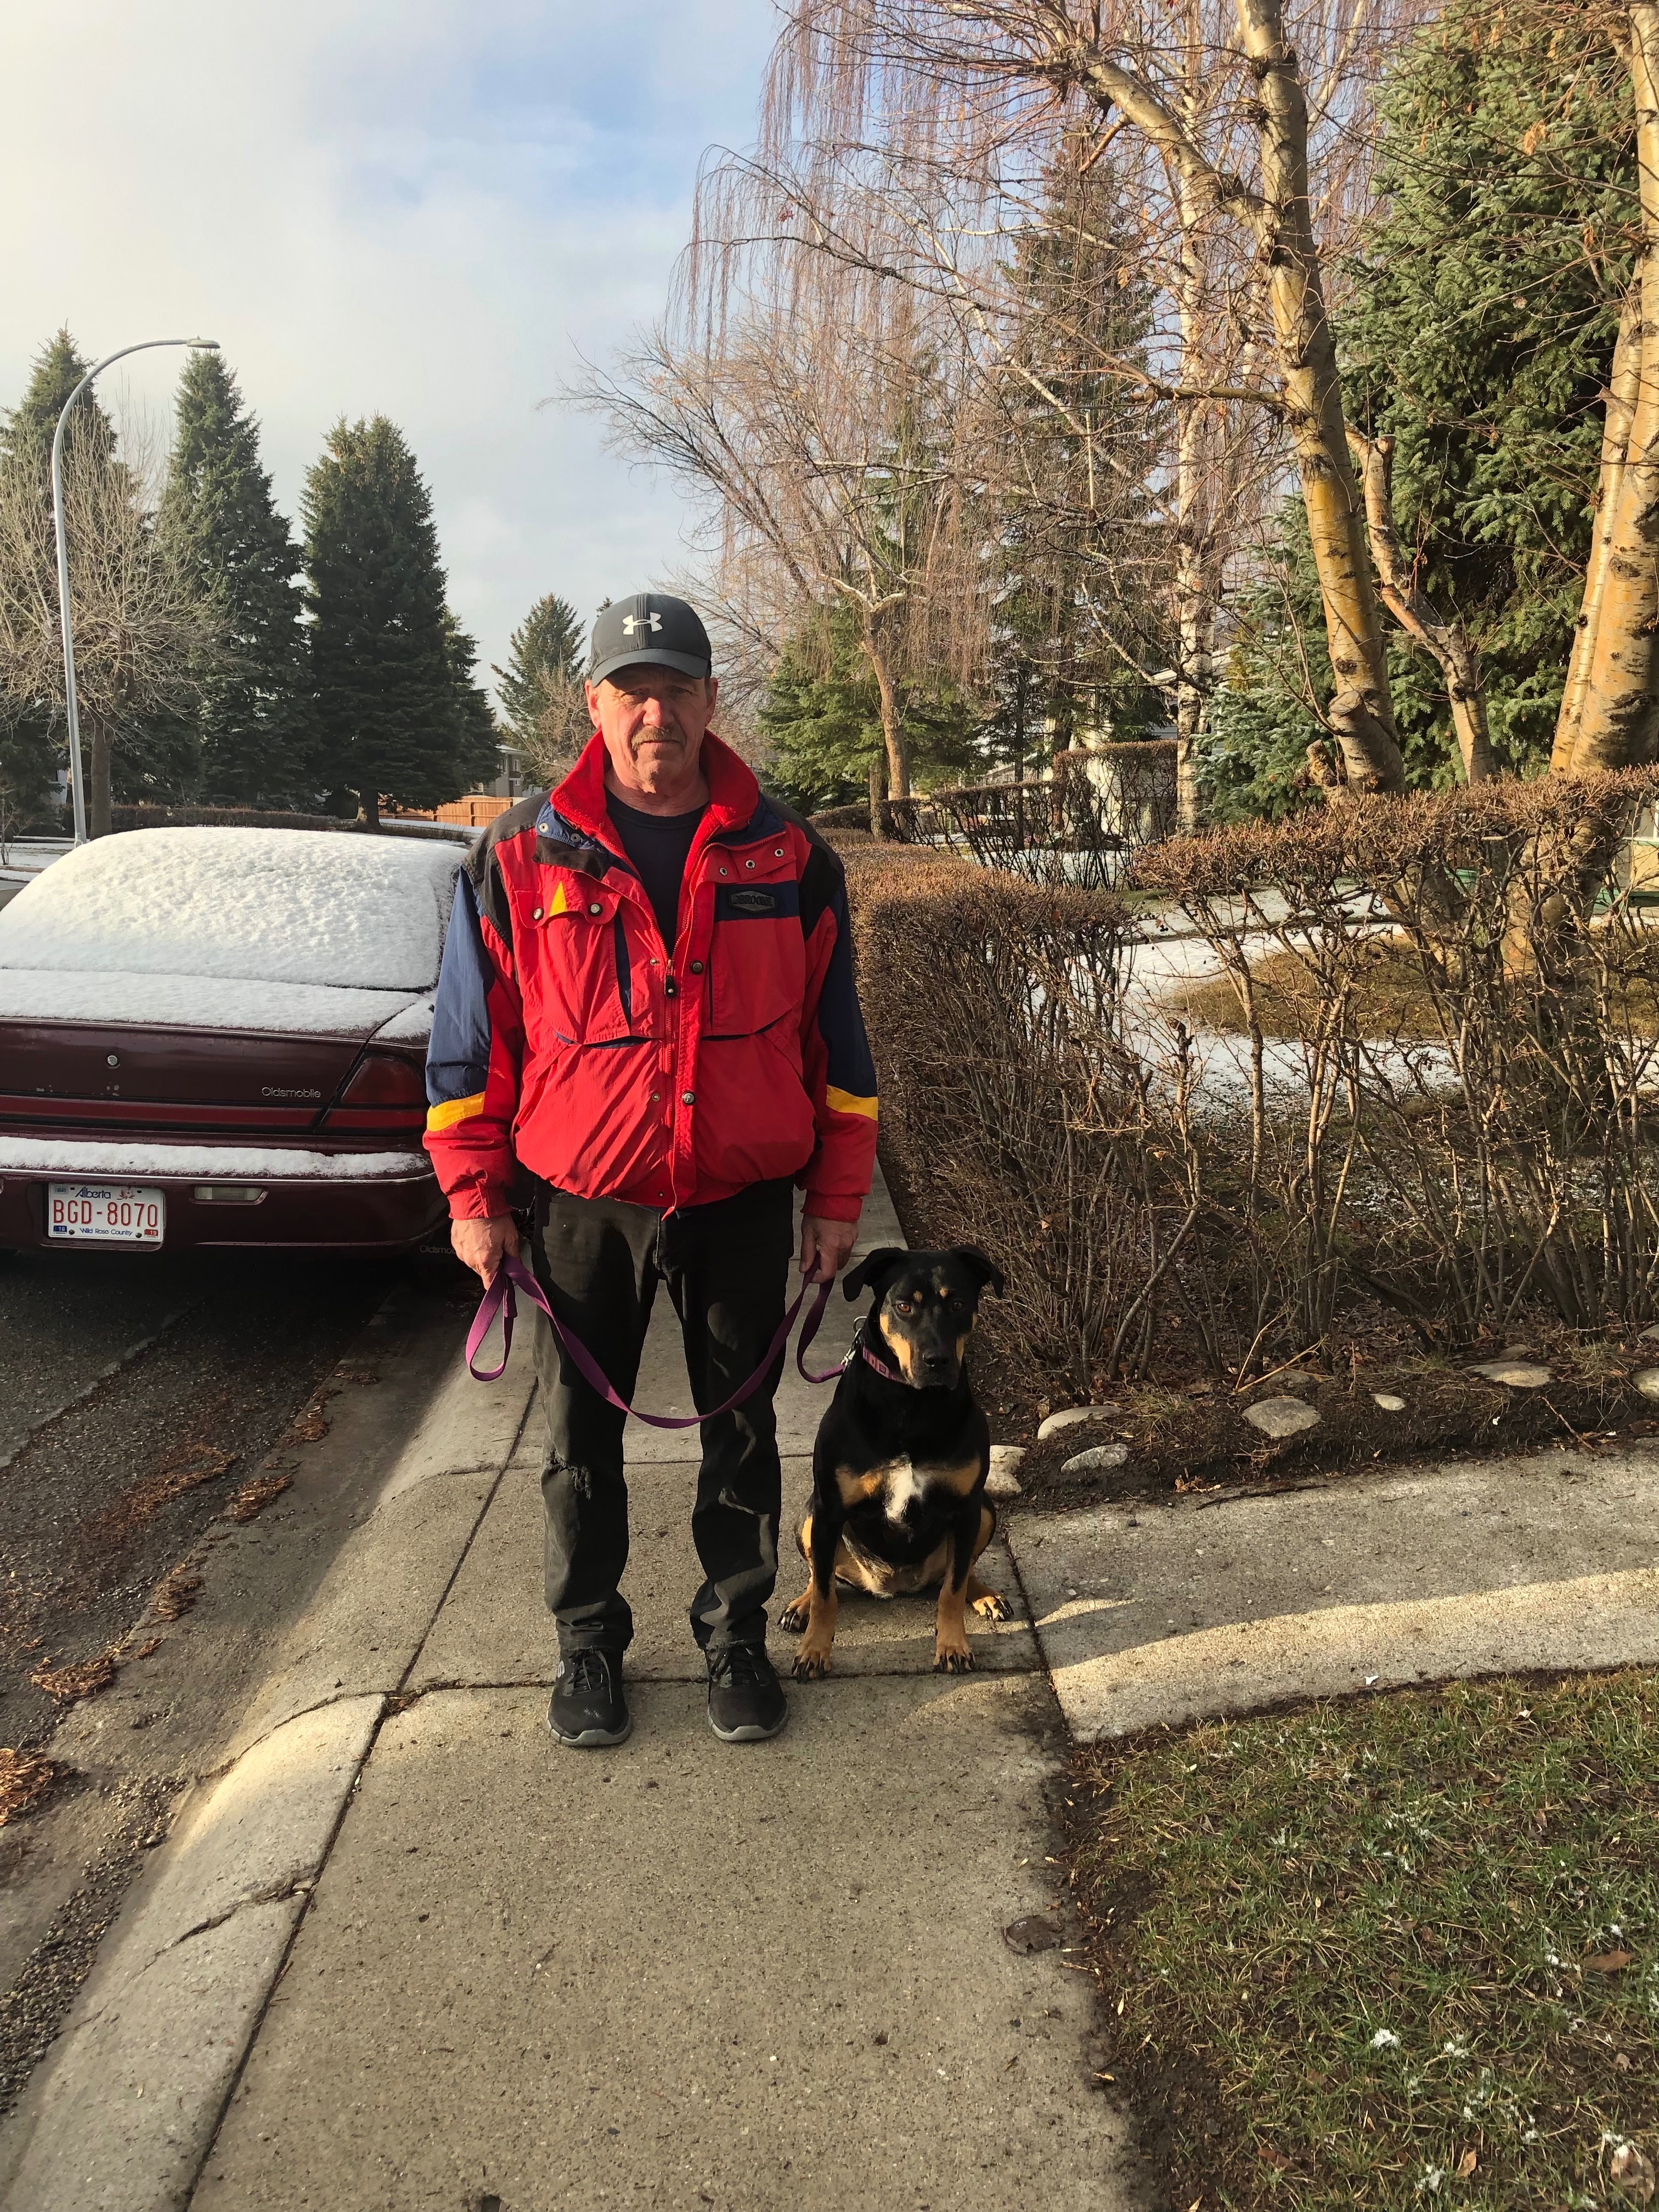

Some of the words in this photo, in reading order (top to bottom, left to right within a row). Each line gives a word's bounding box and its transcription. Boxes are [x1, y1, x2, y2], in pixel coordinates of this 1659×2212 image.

[262, 1087, 321, 1098] Oldsmobile
[75, 1186, 111, 1199] Alberta
[53, 1199, 158, 1228] BGD-8070
